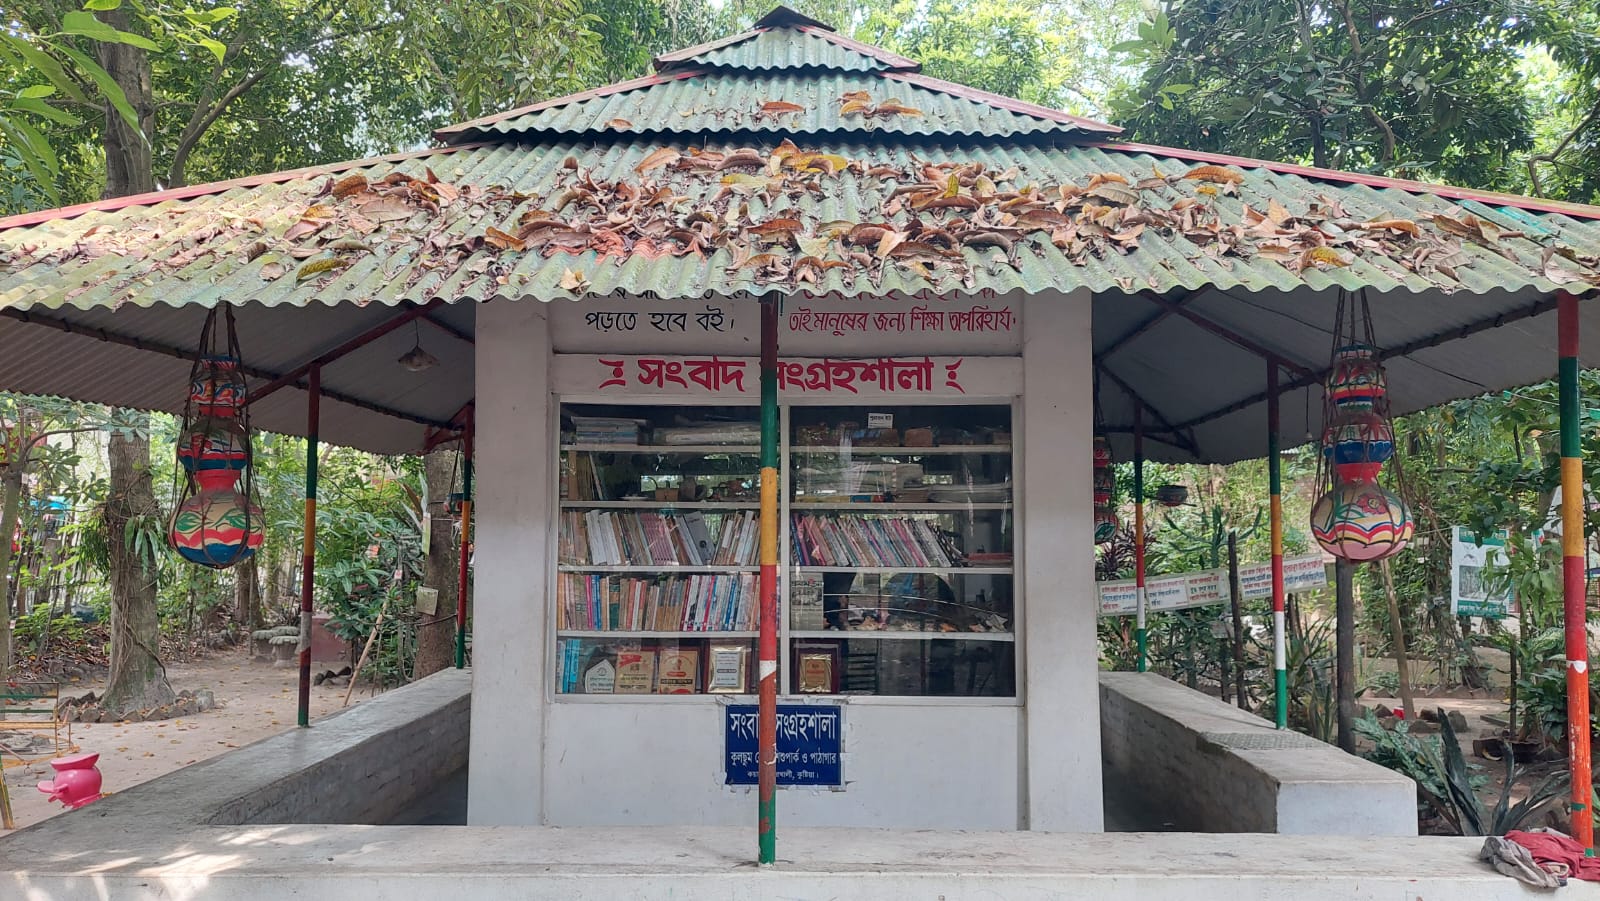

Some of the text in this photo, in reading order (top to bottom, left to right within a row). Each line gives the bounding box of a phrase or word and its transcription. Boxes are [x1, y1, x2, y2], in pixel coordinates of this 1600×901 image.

[585, 311, 638, 333] পড়তে
[648, 312, 688, 332] হবে
[813, 312, 869, 336] মানুষের
[872, 312, 905, 333] জন্য
[910, 304, 944, 331] শিক্ষা
[637, 355, 747, 392] সংবাদ
[730, 713, 759, 740] সংবা
[802, 753, 808, 763] ও
[810, 748, 837, 765] পাঠাগার
